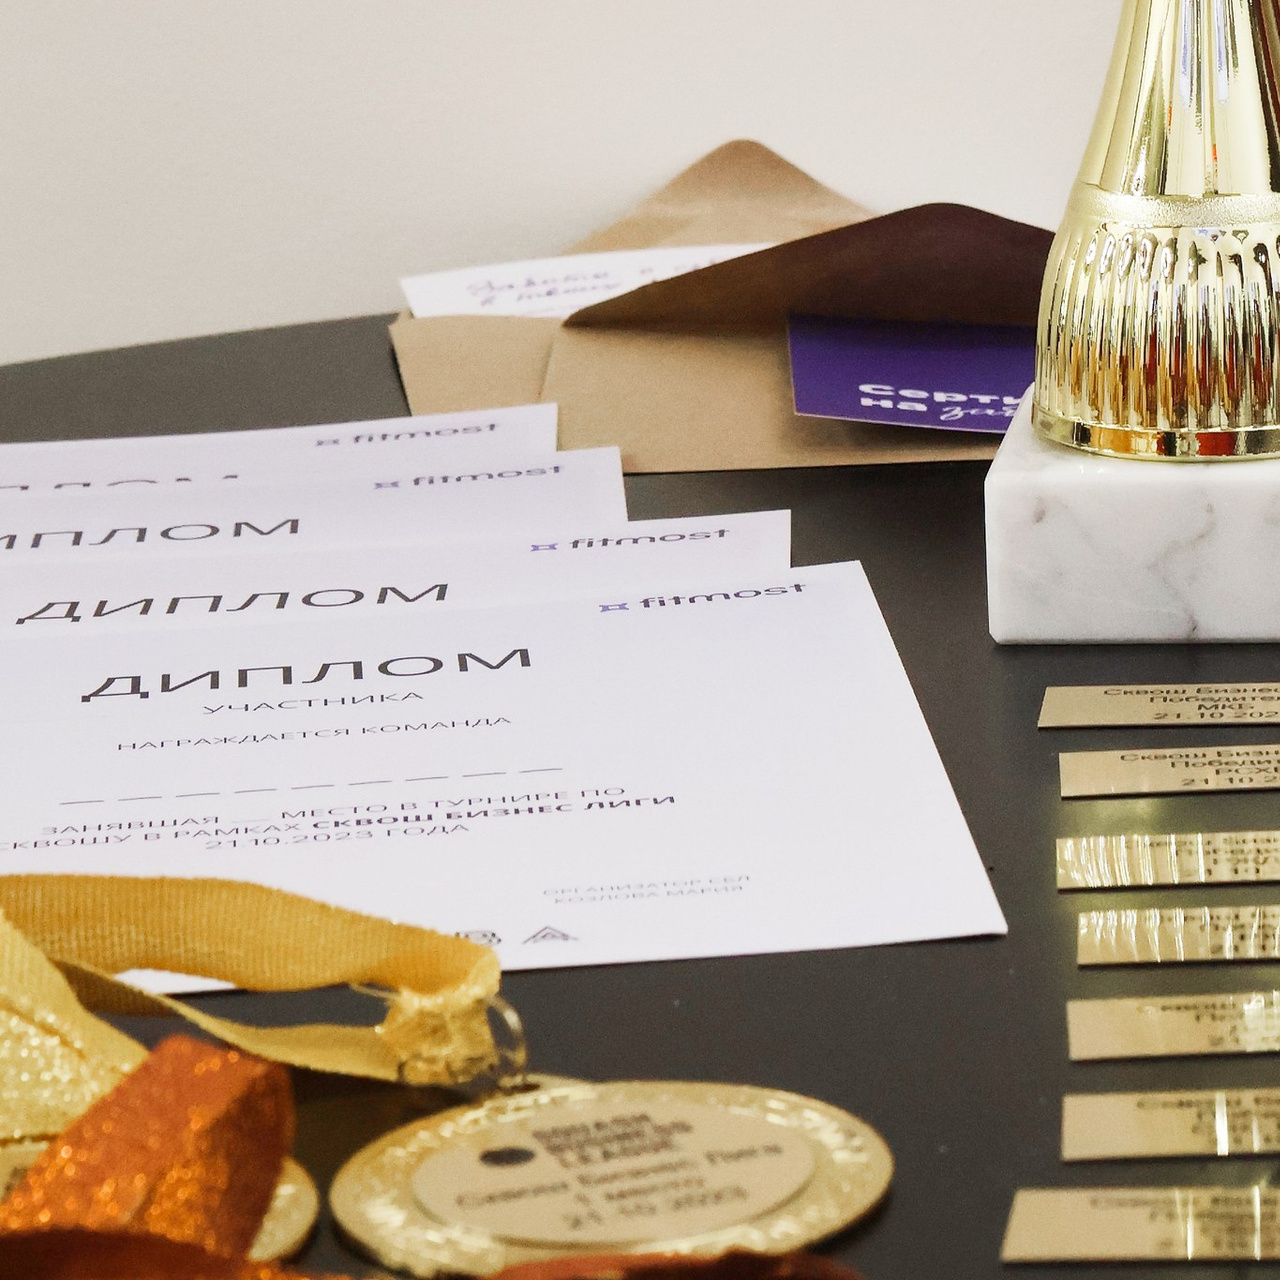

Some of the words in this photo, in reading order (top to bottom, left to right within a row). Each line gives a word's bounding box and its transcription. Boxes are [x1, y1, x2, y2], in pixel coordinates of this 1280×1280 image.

[859, 397, 928, 412] на
[353, 423, 500, 444] fitmost
[413, 465, 563, 486] fitmost
[569, 528, 730, 549] fitmost
[14, 583, 450, 625] ДИПЛОМ
[639, 583, 807, 609] fitmost
[81, 648, 533, 703] ДИПЛОМ
[202, 691, 425, 715] УЧАСТНИКА
[117, 728, 350, 751] НАГРАЖДАЕТСЯ
[361, 717, 512, 734] КОМАНДА
[0, 835, 132, 851] КВОШУ
[144, 832, 161, 841] В
[174, 823, 302, 839] РАМКАХ
[312, 814, 434, 829] СКВОШ
[445, 804, 574, 820] БИЗНЕС
[583, 796, 676, 811] ЛИГИ
[42, 816, 219, 836] ЗАНЯВШАЯ
[281, 804, 388, 820] МЕСТО
[400, 802, 418, 811] В
[433, 791, 570, 809] ТУРНИРЕ
[580, 787, 626, 798] ПО
[205, 831, 375, 850] 21.10.2023
[385, 824, 471, 837] ГОДА
